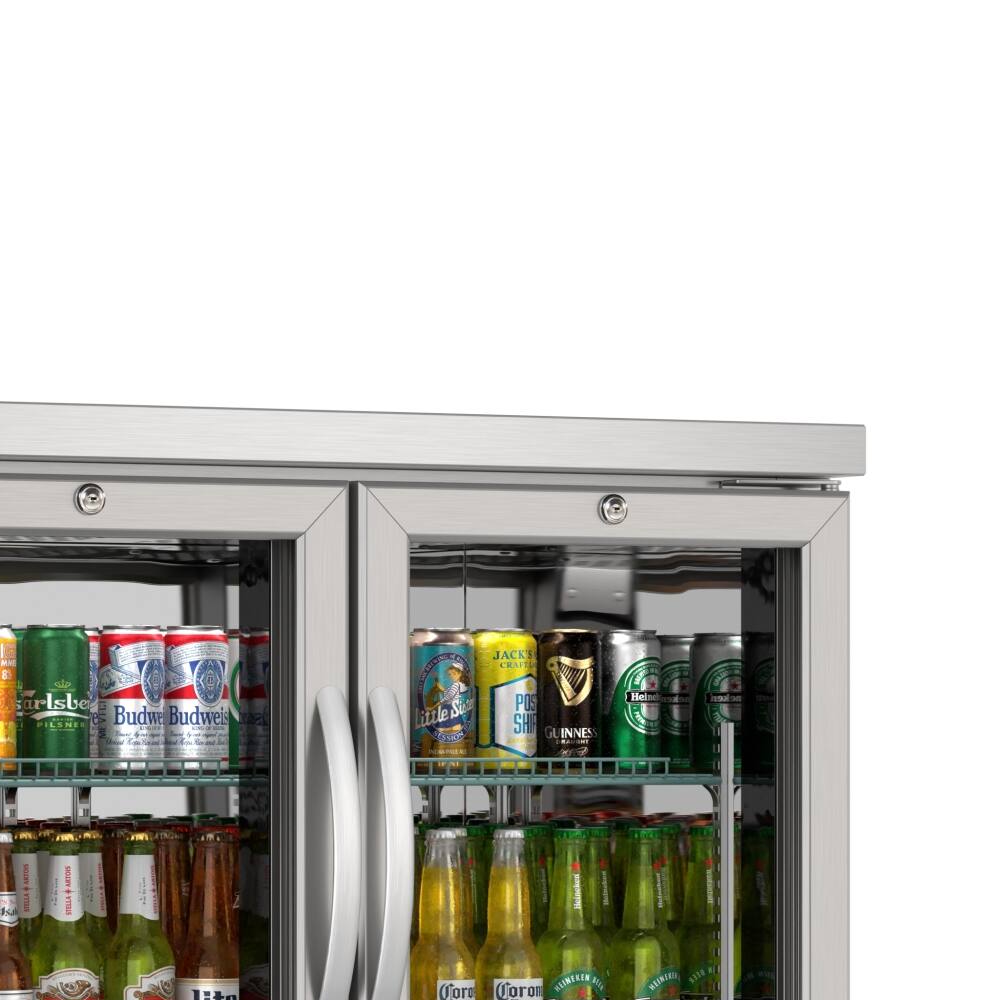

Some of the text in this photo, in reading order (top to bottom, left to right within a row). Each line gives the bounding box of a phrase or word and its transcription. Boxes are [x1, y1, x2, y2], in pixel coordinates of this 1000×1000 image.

[545, 725, 597, 739] GUINNESS
[64, 865, 72, 888] ARTOIS
[573, 873, 581, 910] Heineken
[554, 973, 590, 992] HEINEKEN
